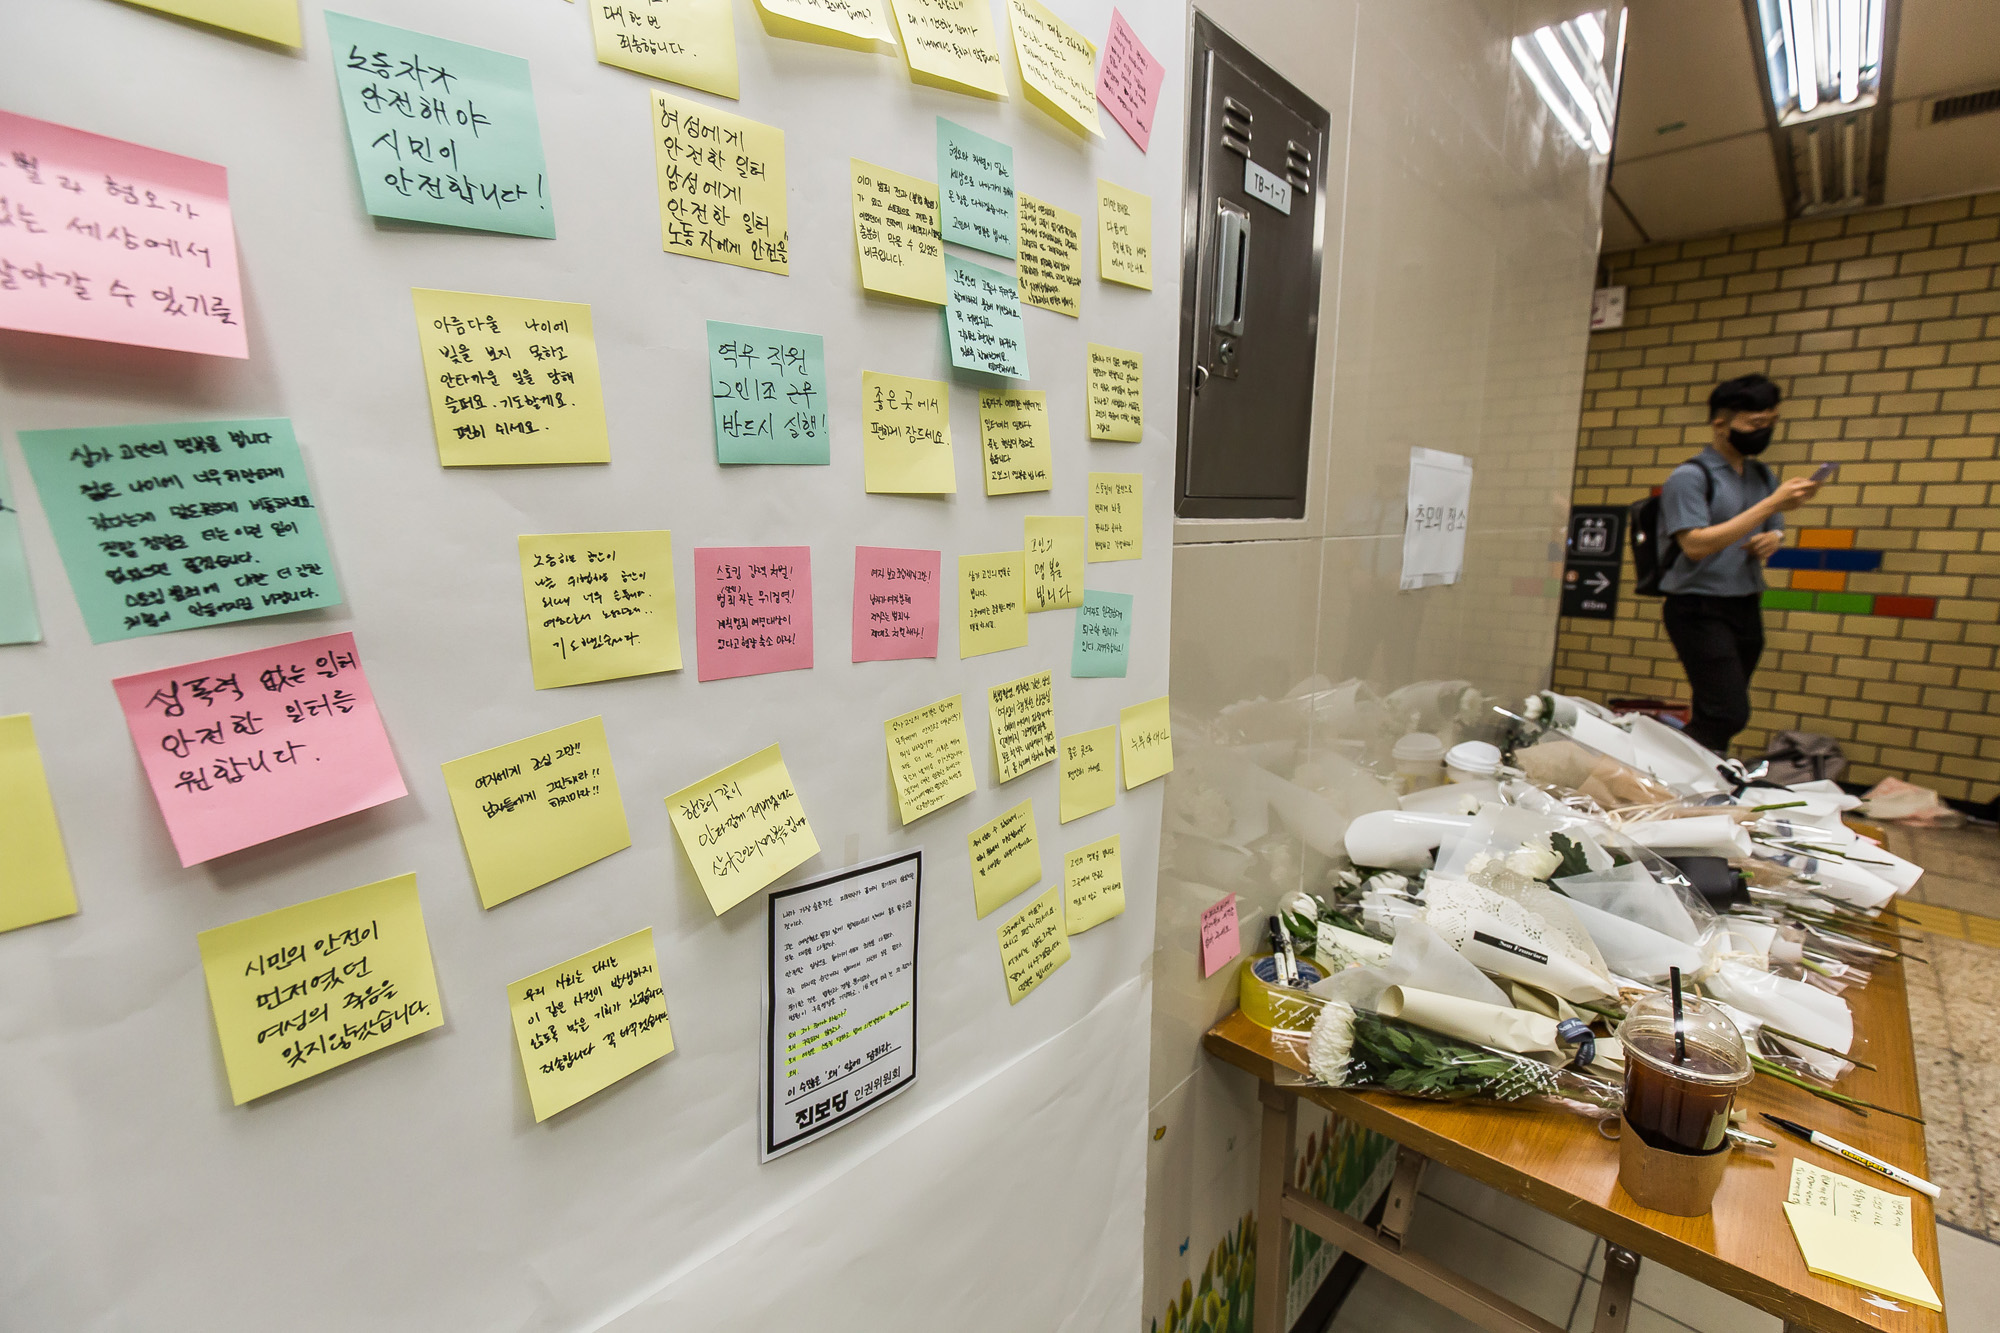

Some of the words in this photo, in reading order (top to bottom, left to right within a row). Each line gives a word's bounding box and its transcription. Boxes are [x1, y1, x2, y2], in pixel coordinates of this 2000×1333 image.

[630, 11, 642, 26] 한
[647, 15, 661, 28] 번
[348, 45, 457, 94] 노동자가
[361, 86, 491, 137] 안전해야
[373, 129, 458, 171] 시민이
[664, 137, 725, 172] 안전한
[736, 155, 766, 181] 일터
[384, 168, 548, 210] 안전합니다!
[666, 164, 742, 205] 남성에게
[857, 175, 872, 187] 이미
[1255, 173, 1285, 204] TB-1-7
[668, 198, 730, 226] 안전한
[743, 211, 769, 237] 일터
[952, 217, 970, 230] 고인의
[66, 217, 211, 268] 세상에서
[669, 222, 741, 256] 노동자에게
[907, 240, 913, 251] 수
[863, 246, 904, 266] 비극입니다.
[110, 279, 136, 308] 수
[152, 286, 237, 325] 있기를
[525, 319, 568, 333] 나이에
[485, 347, 511, 361] 보지
[529, 345, 568, 361] 못하고
[719, 341, 760, 369] 역무
[767, 345, 808, 376] 직원
[441, 370, 500, 389] 안타까운
[513, 369, 535, 385] 일을
[547, 369, 574, 384] 당해
[787, 381, 817, 409] 근무
[874, 387, 898, 412] 좋은
[723, 410, 773, 440] 반드시
[784, 412, 826, 438] 실행!
[871, 422, 901, 440] 편하게
[905, 426, 950, 445] 잠드세요.
[985, 418, 1009, 431] 일터에서
[129, 475, 184, 493] 나이에
[1096, 483, 1112, 495] 스토킹이
[1415, 504, 1444, 532] 추모의
[1447, 507, 1465, 532] 장소
[1031, 538, 1053, 553] 고인의
[717, 565, 742, 580] 스토킹
[748, 564, 767, 578] 강력
[770, 564, 793, 581] 처벌!
[583, 592, 603, 604] 너무
[1036, 585, 1071, 608] 빕니다
[870, 629, 890, 638] 제대로
[259, 664, 306, 692] 없는
[315, 650, 357, 678] 일터
[161, 711, 264, 758] 안전한
[285, 690, 357, 724] 일터를
[174, 740, 320, 793] 원합니다.
[475, 764, 521, 789] 여자에게
[531, 753, 552, 771] 조심
[482, 790, 536, 819] 남자들에게
[712, 851, 739, 877] 삼가
[245, 944, 307, 977] 시민의
[313, 920, 379, 957] 안전이
[1499, 940, 1513, 950] San
[523, 986, 545, 1002] 우리
[555, 969, 585, 989] 사회는
[592, 956, 618, 973] 다시는
[527, 1012, 541, 1025] 이
[545, 1000, 567, 1018] 같은
[573, 986, 603, 1006] 사건이
[611, 964, 653, 989] 발생하지
[257, 1003, 329, 1044] 여성의
[342, 979, 399, 1010] 죽음을
[530, 1025, 559, 1050] 않도록
[594, 1001, 621, 1020] 기회가
[539, 1042, 595, 1074] 죄송합니다
[603, 1032, 616, 1048] 꼭
[787, 1087, 795, 1096] 이
[799, 1076, 821, 1093] 수많은
[795, 1090, 848, 1130] 진보당
[854, 1066, 901, 1101] 인권위원회
[1842, 1150, 1884, 1172] namepen
